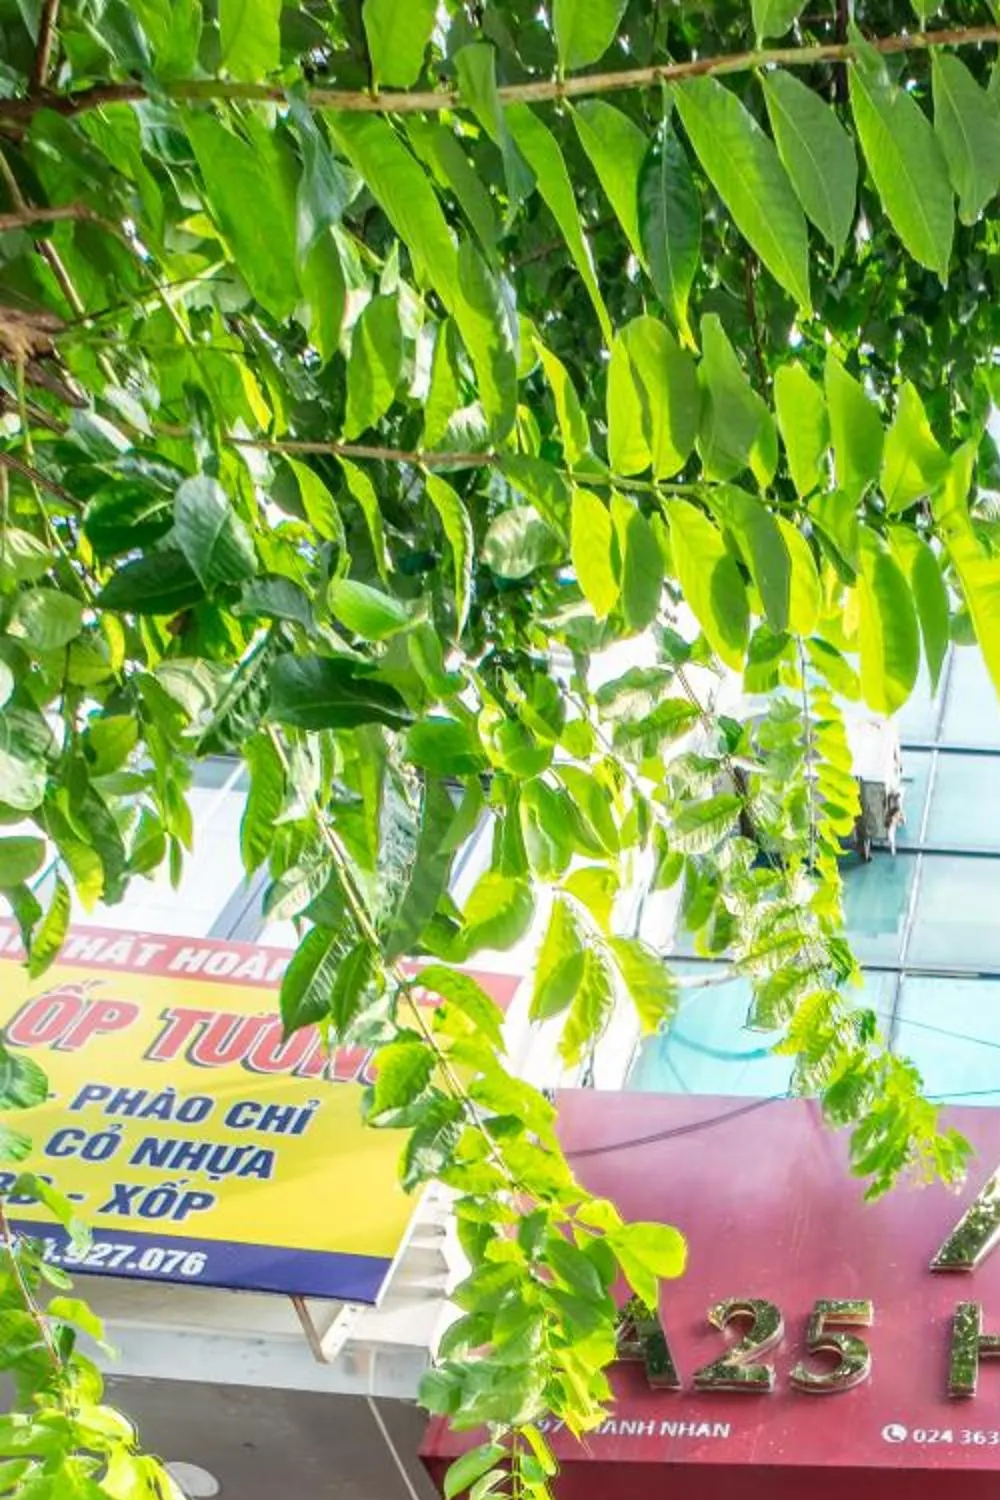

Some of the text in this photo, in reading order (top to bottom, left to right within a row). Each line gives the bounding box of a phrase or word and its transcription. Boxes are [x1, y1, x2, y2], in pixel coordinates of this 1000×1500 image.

[7, 980, 140, 1051] ỐP
[69, 1084, 215, 1123] PHÀO
[224, 1099, 321, 1135] CHỈ
[129, 1137, 276, 1181] NHỰA
[98, 1178, 216, 1221] XỐP
[613, 1297, 876, 1394] A25
[912, 1428, 954, 1444] 024
